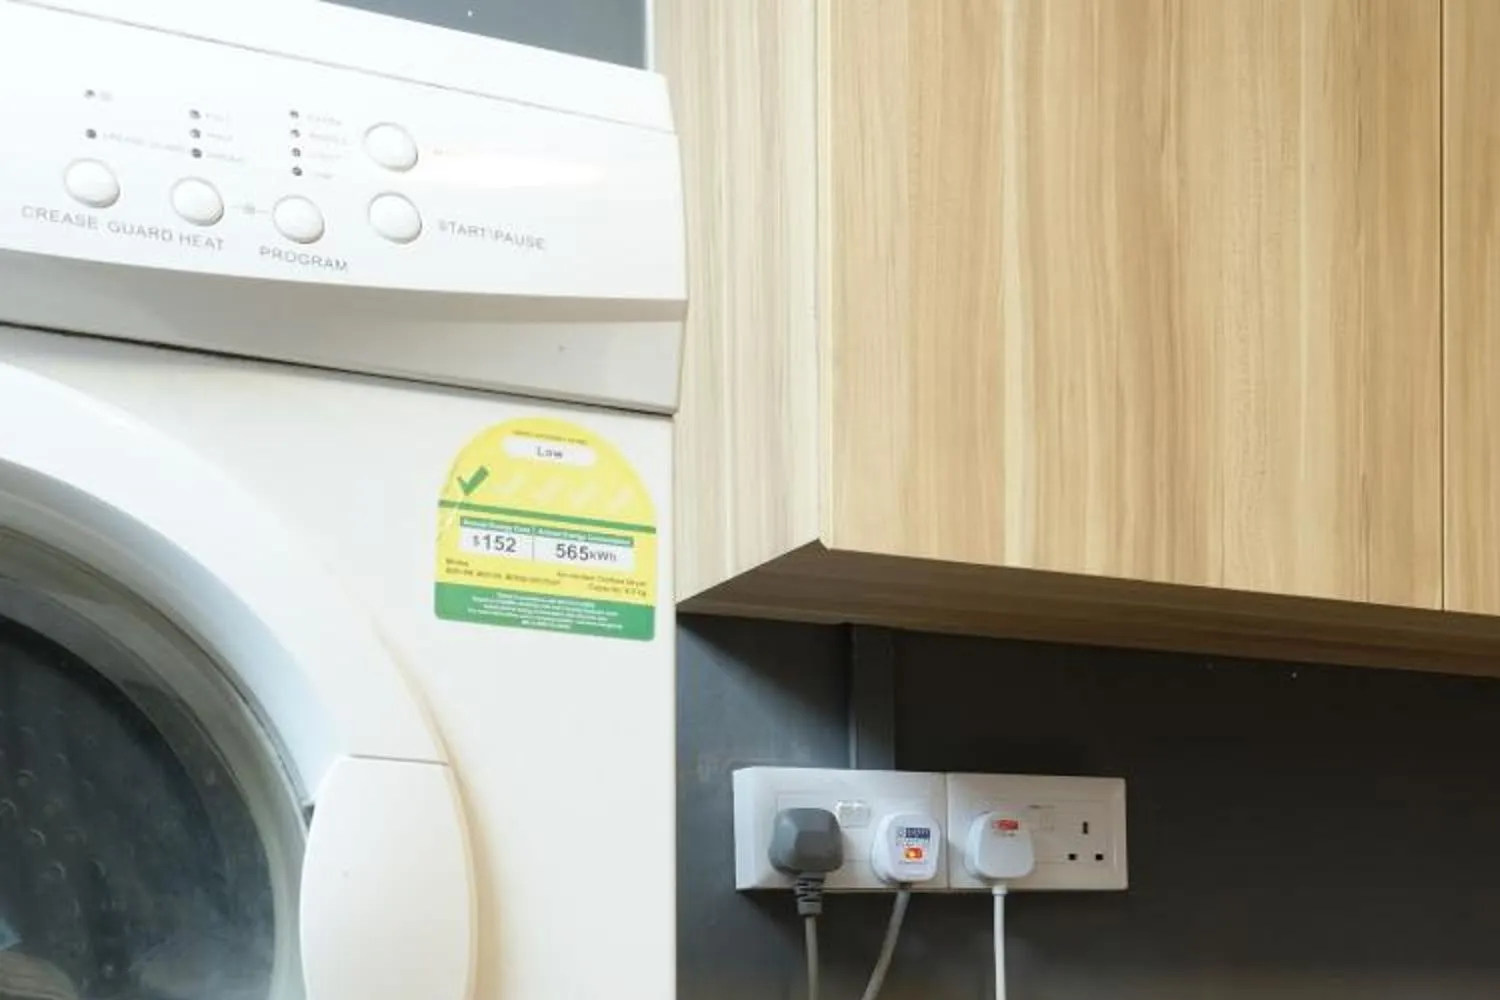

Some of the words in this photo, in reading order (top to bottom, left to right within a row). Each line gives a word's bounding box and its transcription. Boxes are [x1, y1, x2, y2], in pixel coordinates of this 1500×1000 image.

[20, 204, 99, 231] CREASE
[106, 218, 174, 243] GUARD
[178, 233, 226, 252] HEAT
[259, 244, 350, 272] PROGRAM
